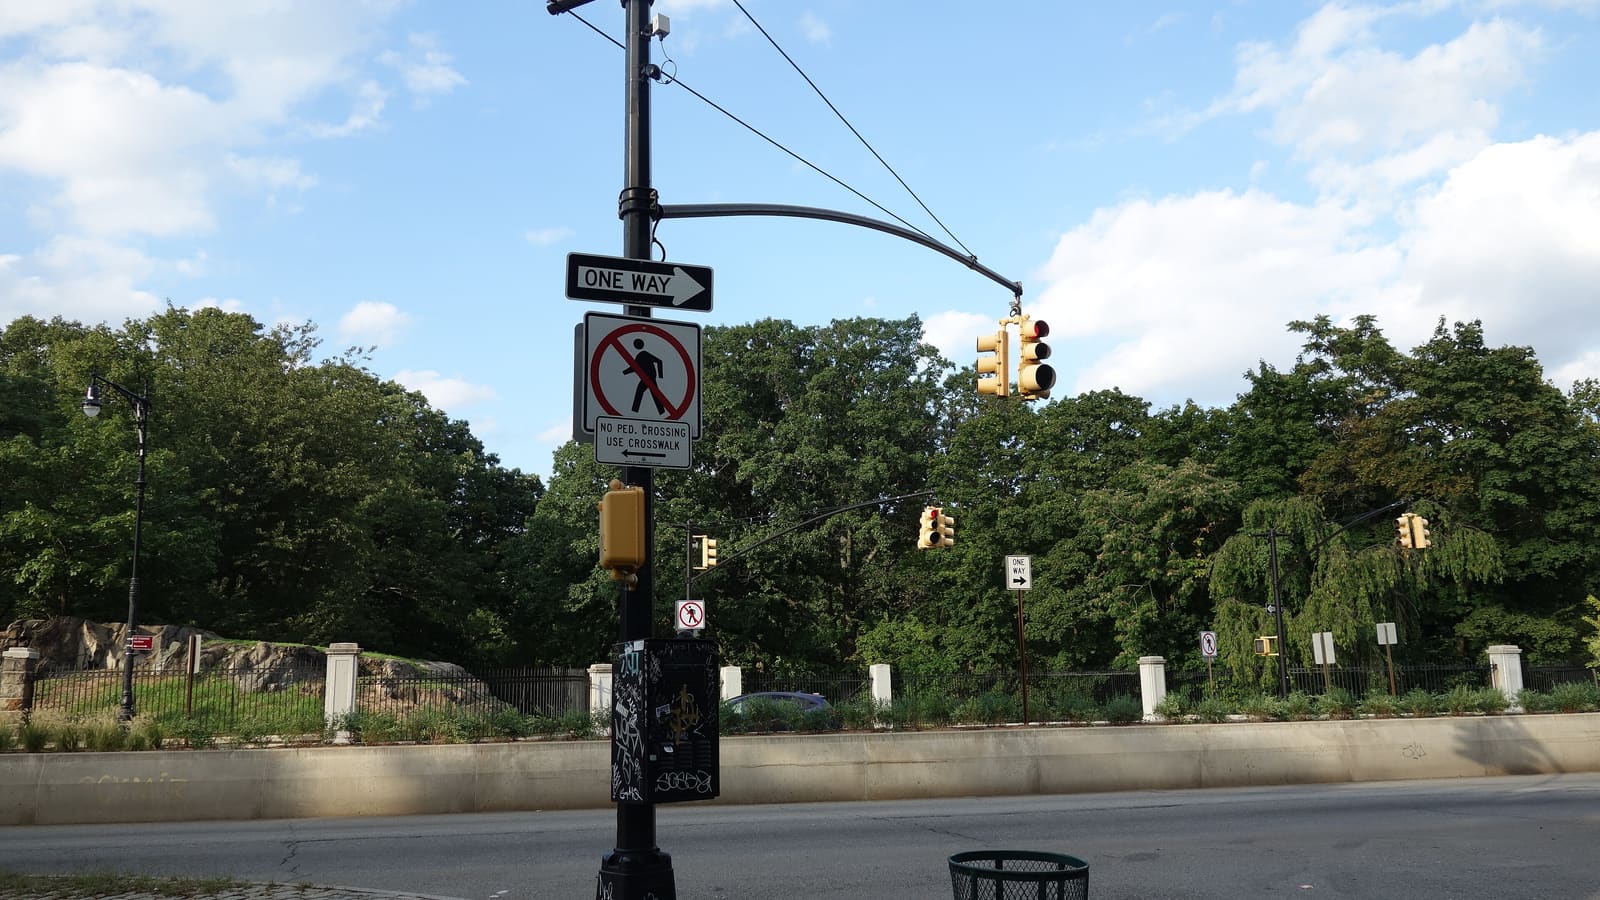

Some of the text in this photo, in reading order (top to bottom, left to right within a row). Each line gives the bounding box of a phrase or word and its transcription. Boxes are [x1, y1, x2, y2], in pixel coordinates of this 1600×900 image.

[585, 269, 672, 294] ONE WAY
[600, 422, 686, 438] NO PED. CROSSING
[606, 436, 680, 451] USE CROSSWALK
[1013, 567, 1026, 575] WAY
